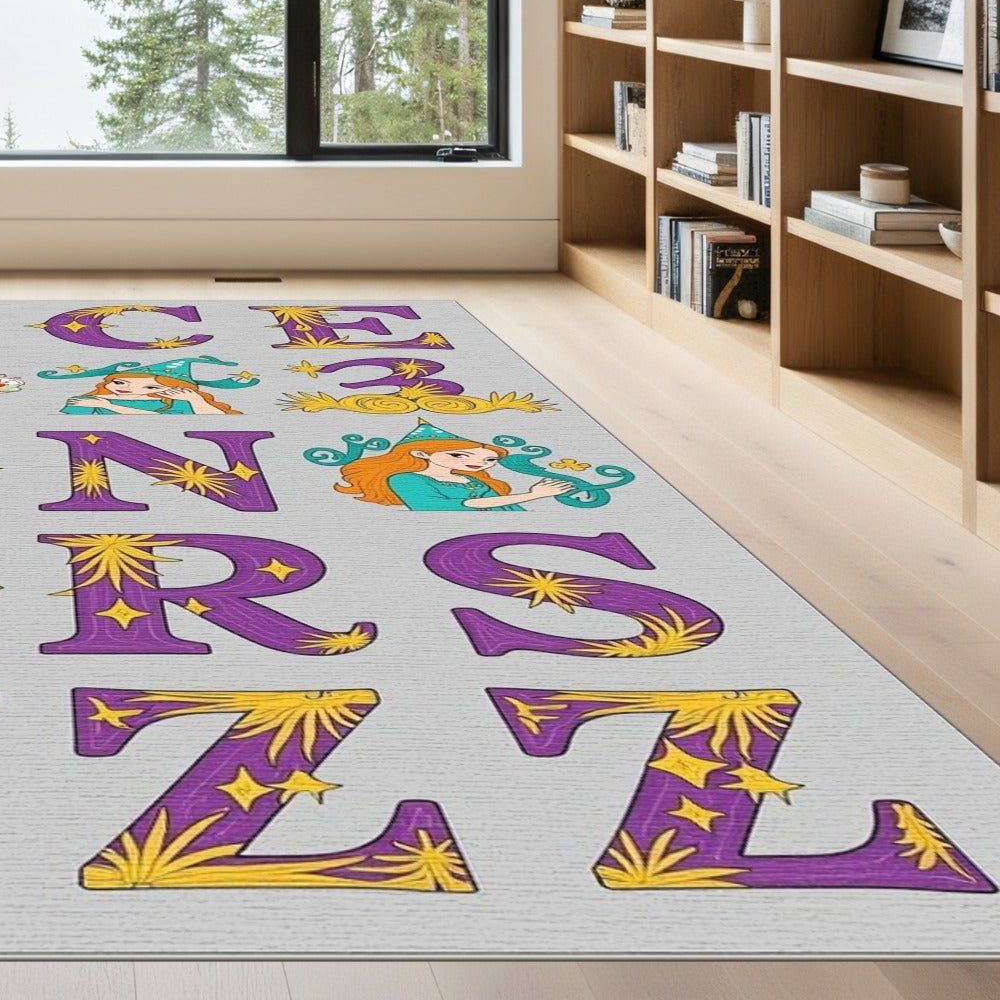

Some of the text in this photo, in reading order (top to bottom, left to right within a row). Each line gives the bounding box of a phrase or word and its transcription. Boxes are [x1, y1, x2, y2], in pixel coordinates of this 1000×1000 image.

[26, 305, 214, 349] C
[248, 305, 455, 349] E
[37, 431, 278, 512] N
[38, 533, 377, 656] R
[424, 533, 723, 658] S
[72, 688, 479, 893] Z
[486, 687, 998, 894] Z
